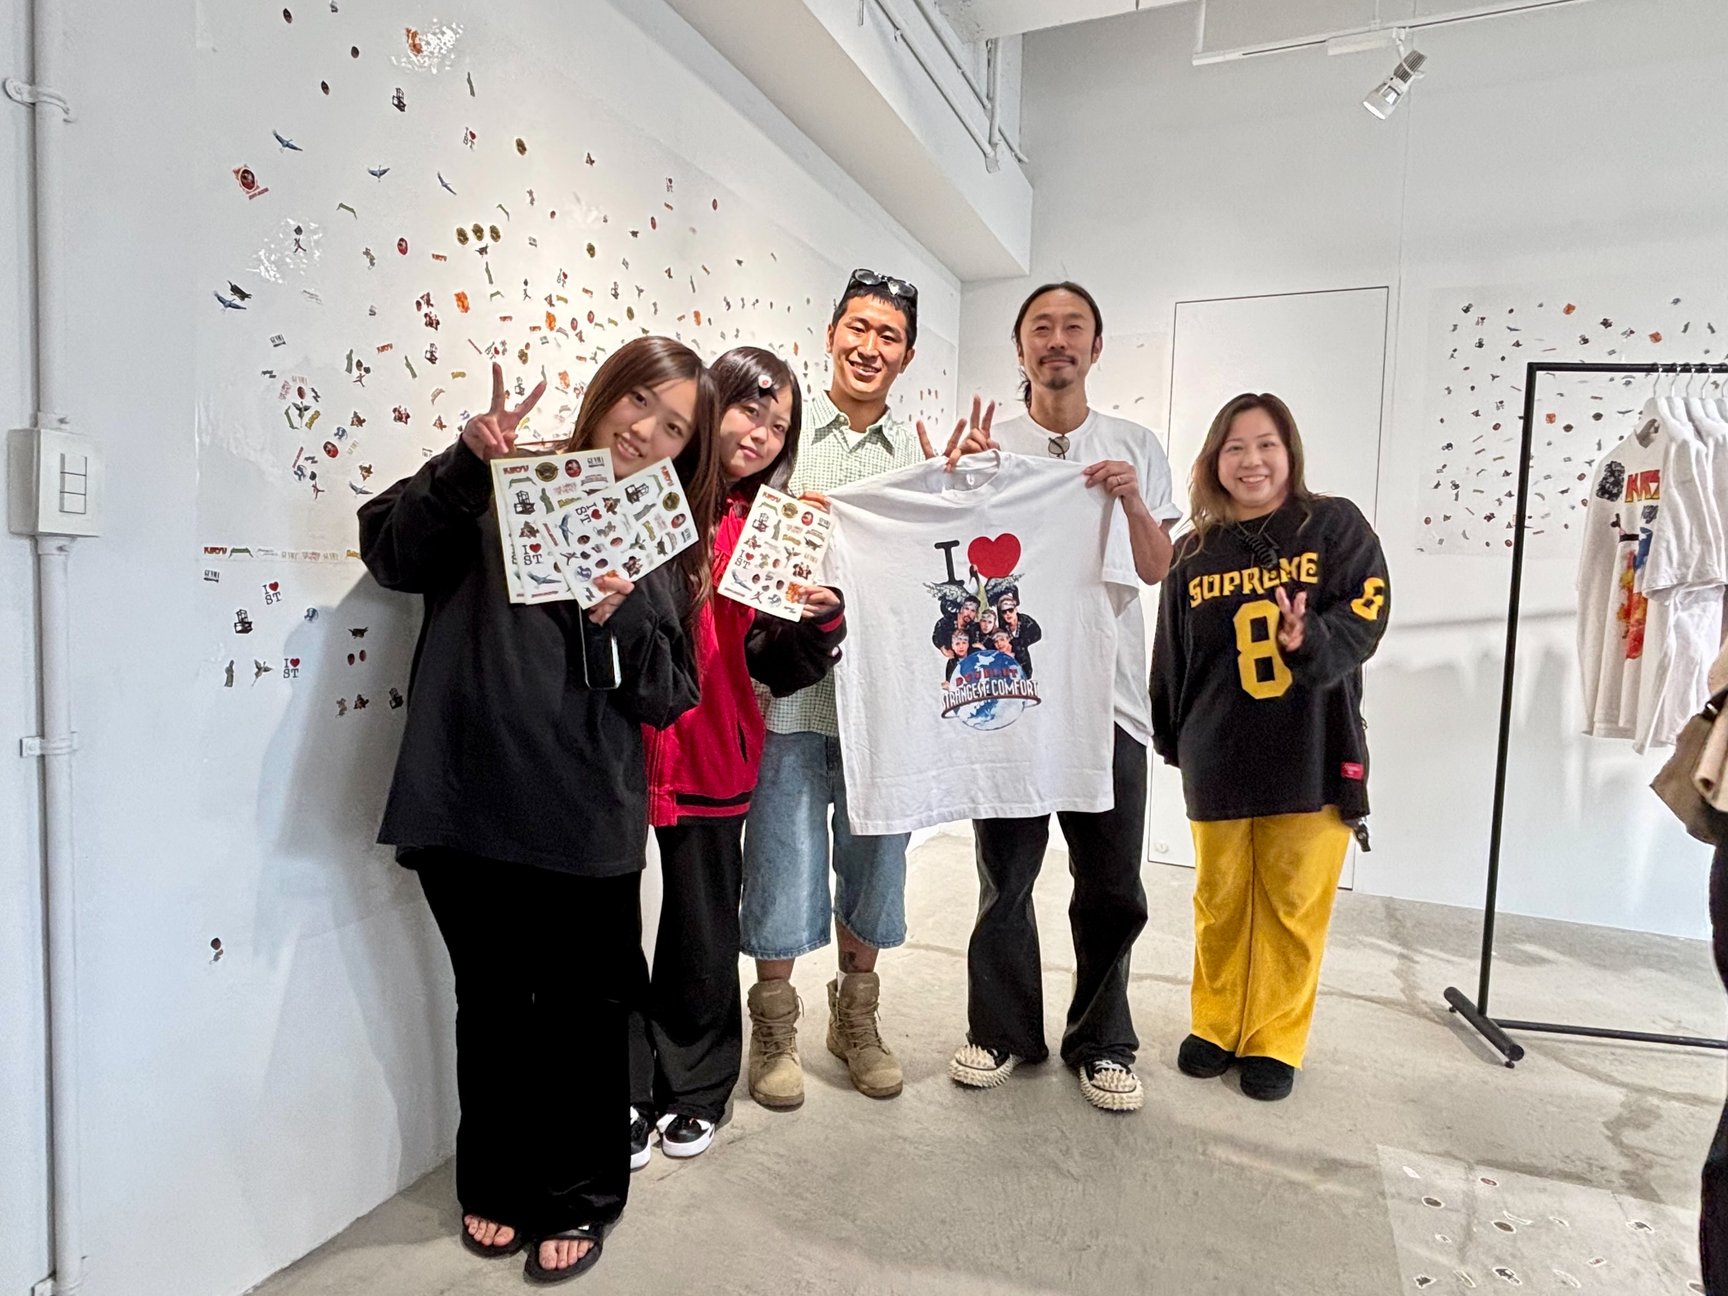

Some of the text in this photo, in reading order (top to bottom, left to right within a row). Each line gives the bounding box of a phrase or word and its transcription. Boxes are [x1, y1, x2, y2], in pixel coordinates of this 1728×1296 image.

[523, 555, 543, 565] ST
[934, 540, 965, 585] I
[1188, 552, 1320, 608] SUPREME
[1233, 599, 1292, 699] 8
[283, 668, 299, 679] ST
[991, 679, 1039, 698] COMFORT
